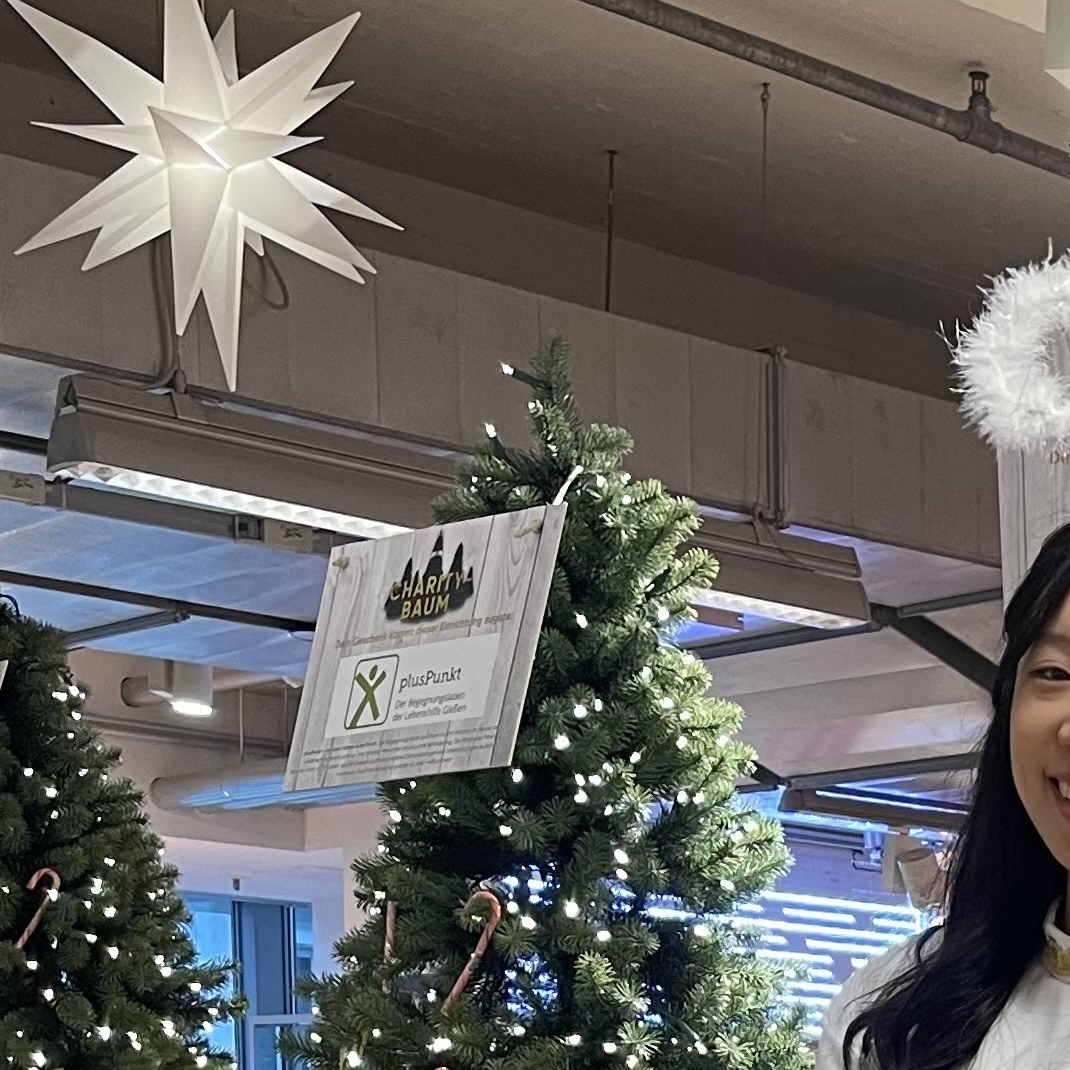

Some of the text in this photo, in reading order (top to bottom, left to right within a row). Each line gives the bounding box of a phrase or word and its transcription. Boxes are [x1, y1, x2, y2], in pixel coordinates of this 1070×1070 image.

[390, 571, 473, 601] CHARITY-
[401, 593, 450, 619] BAUM
[398, 666, 462, 693] plusPunkt
